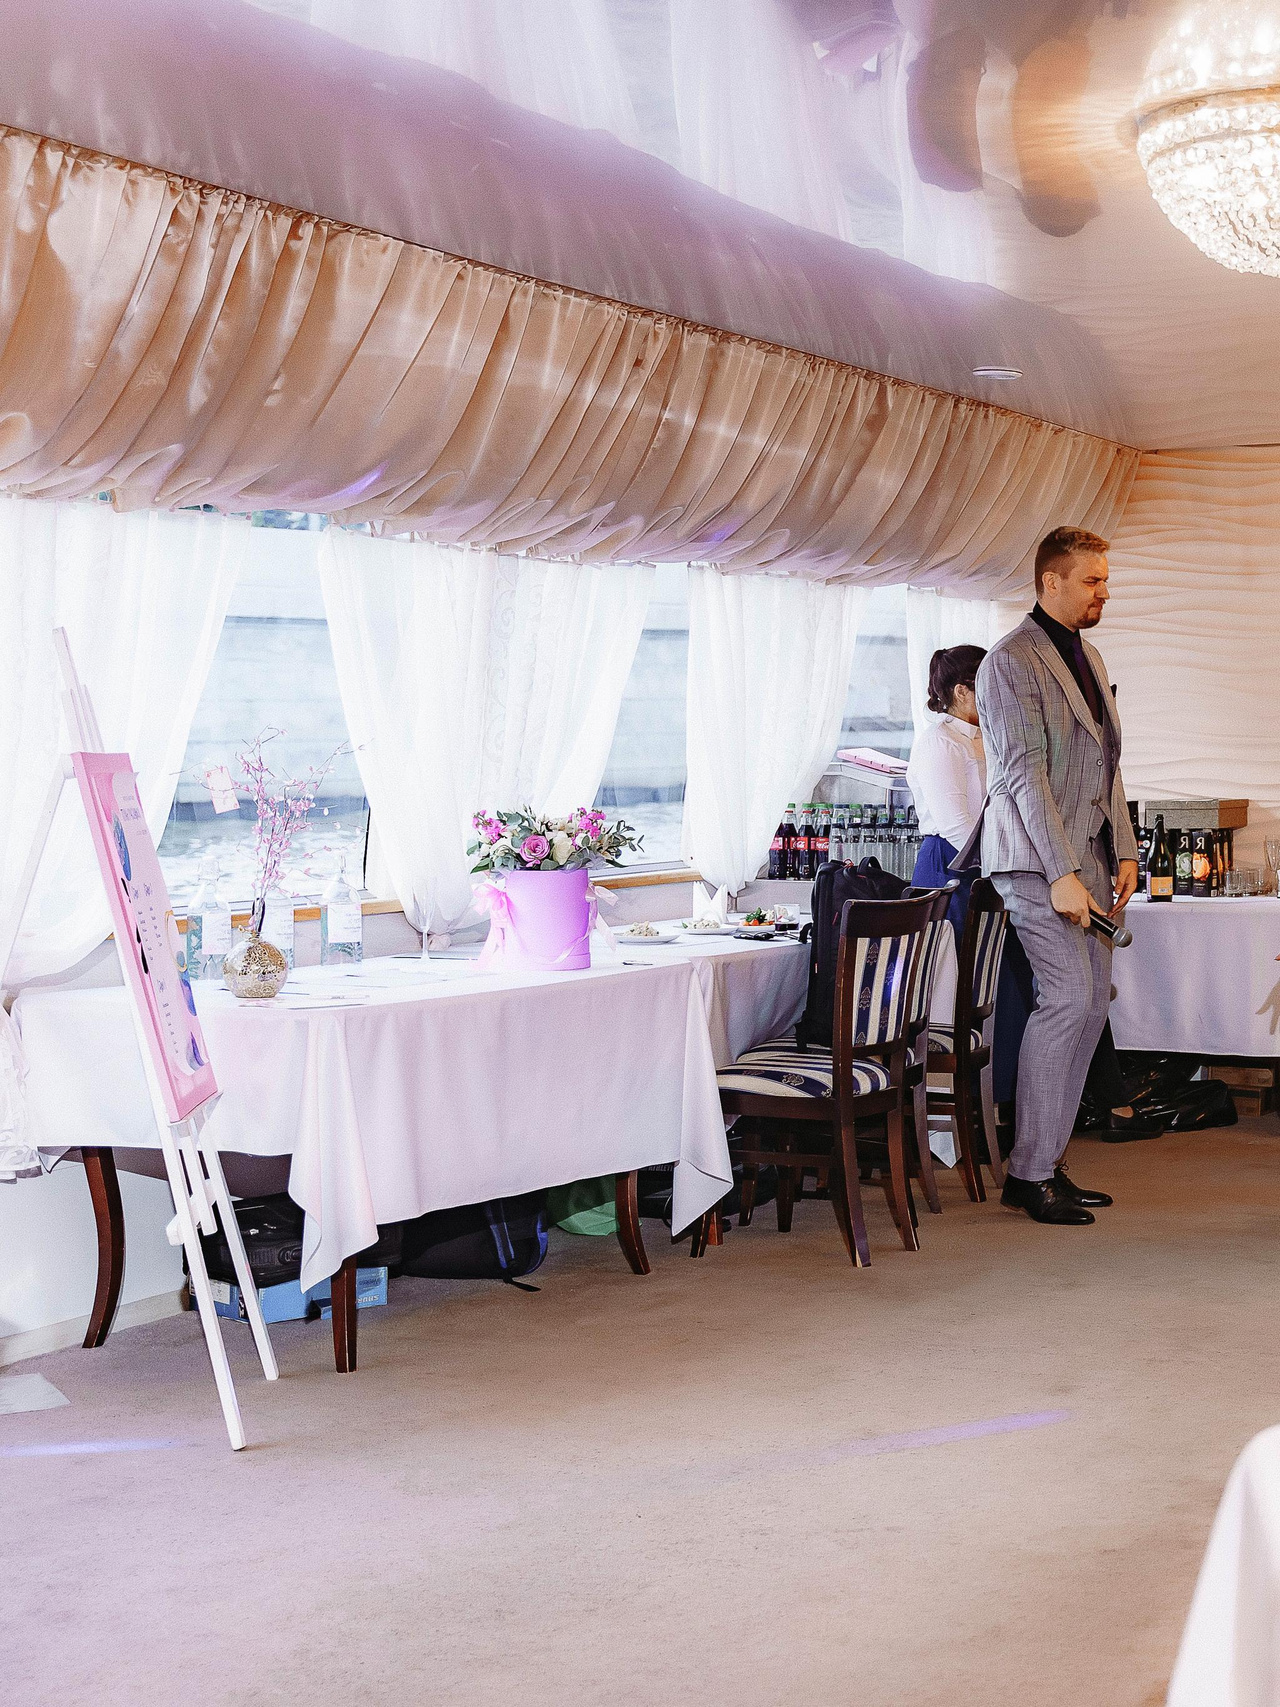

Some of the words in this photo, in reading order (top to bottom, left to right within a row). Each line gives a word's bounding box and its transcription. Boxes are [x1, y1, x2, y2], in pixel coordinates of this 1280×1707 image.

[1179, 836, 1189, 849] Я
[1195, 836, 1205, 850] Я
[357, 1294, 379, 1304] SHUR
